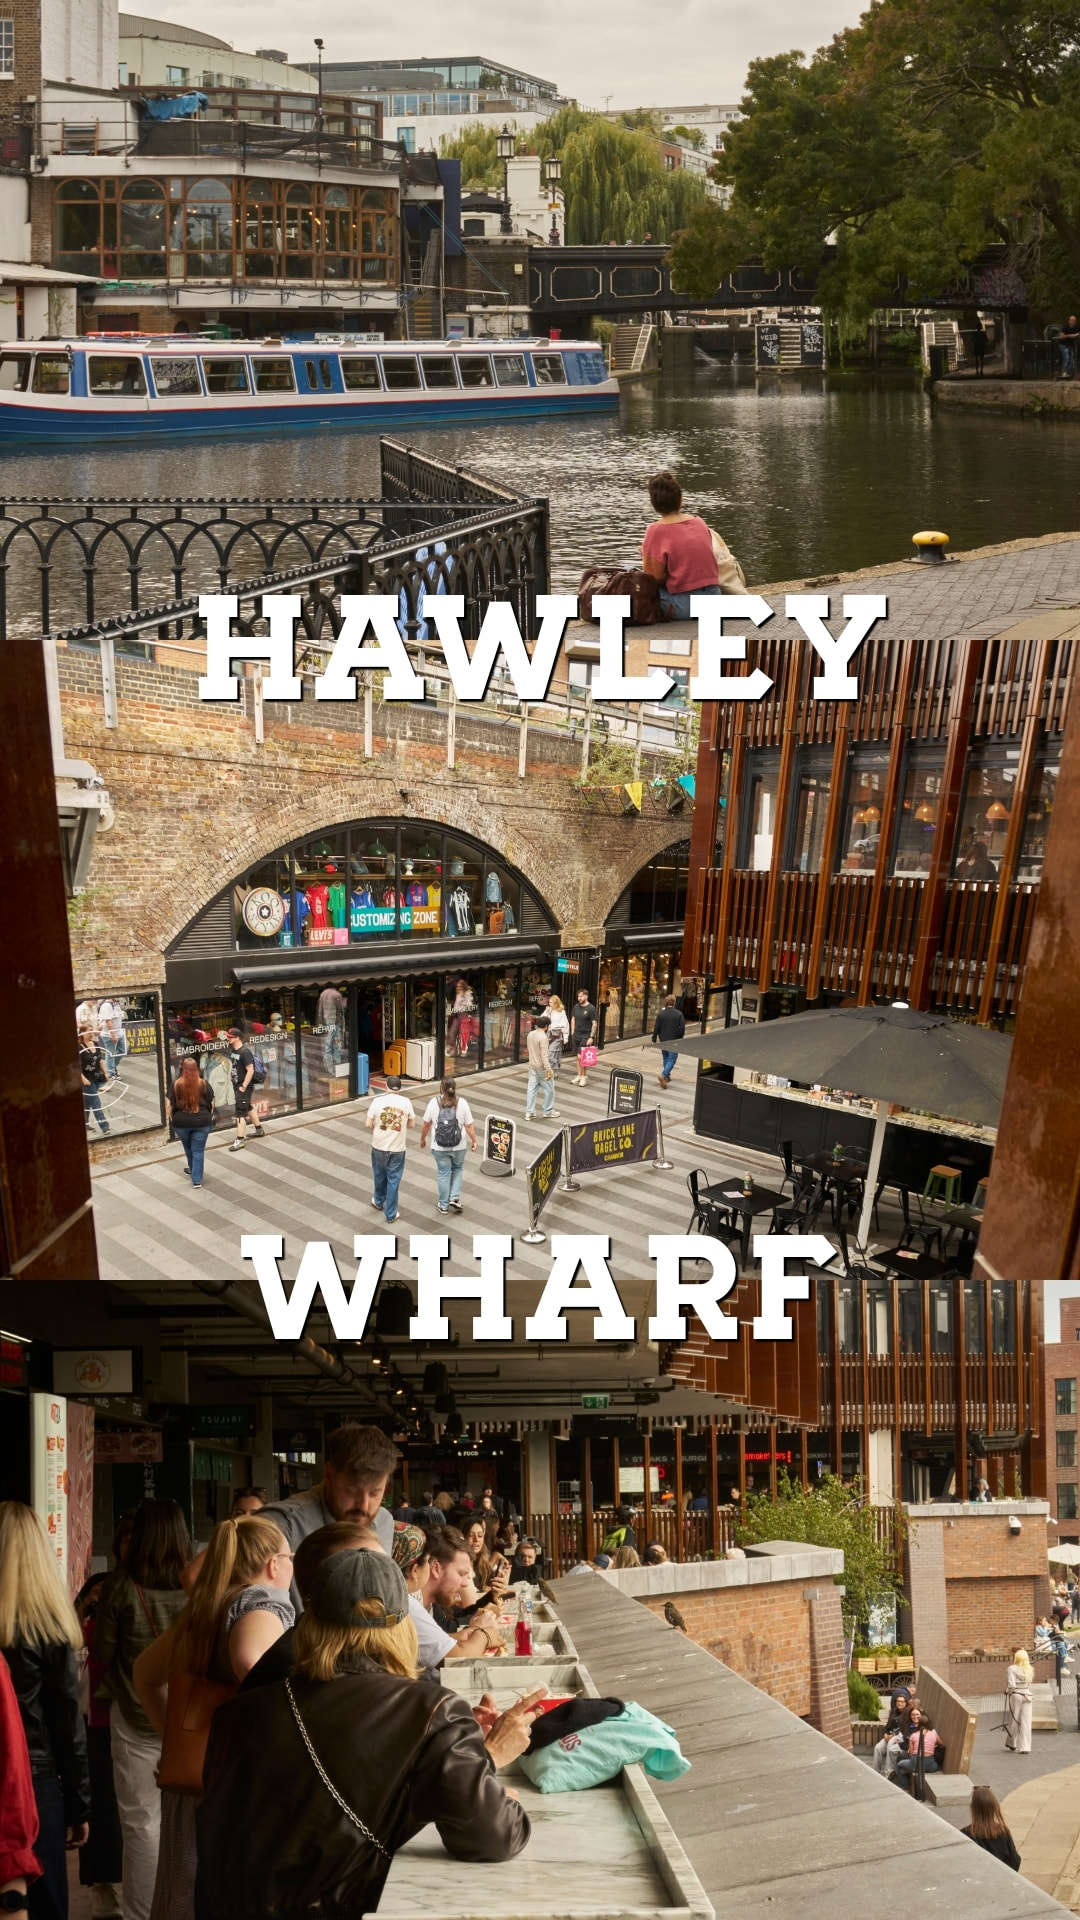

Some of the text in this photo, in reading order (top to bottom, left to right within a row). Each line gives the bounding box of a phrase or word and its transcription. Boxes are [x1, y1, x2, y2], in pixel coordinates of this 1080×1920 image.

[350, 911, 438, 927] USTOMIZNG ZONE
[310, 929, 334, 941] LEVI'S
[312, 1024, 337, 1035] REPAIR
[249, 1031, 288, 1044] REDESIGN
[176, 1040, 230, 1056] EMBROIDERY
[593, 1123, 636, 1143] BRICK LANE
[595, 1140, 617, 1156] BAGEL
[200, 1415, 242, 1424] TSUJIRI
[631, 1455, 668, 1463] STAKS
[795, 1452, 827, 1460] SOKED
